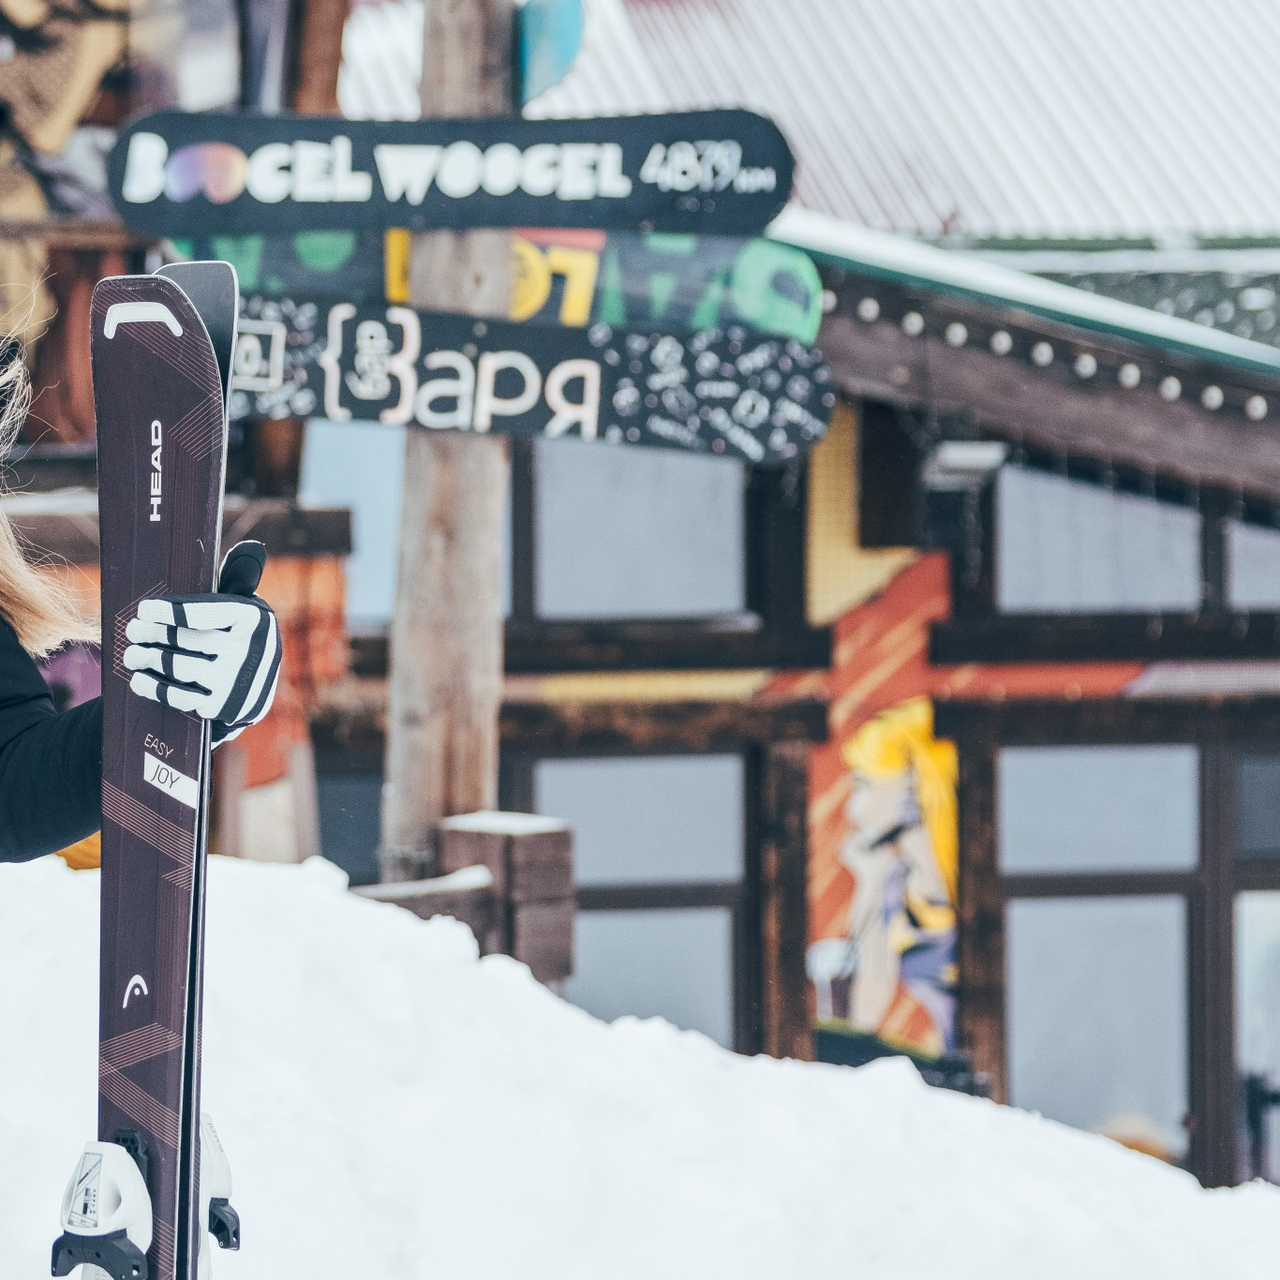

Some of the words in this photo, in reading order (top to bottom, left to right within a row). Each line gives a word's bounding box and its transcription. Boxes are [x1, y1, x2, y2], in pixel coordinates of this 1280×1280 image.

[149, 419, 163, 522] HEAD
[144, 733, 174, 759] EASY
[150, 764, 181, 789] JOY
